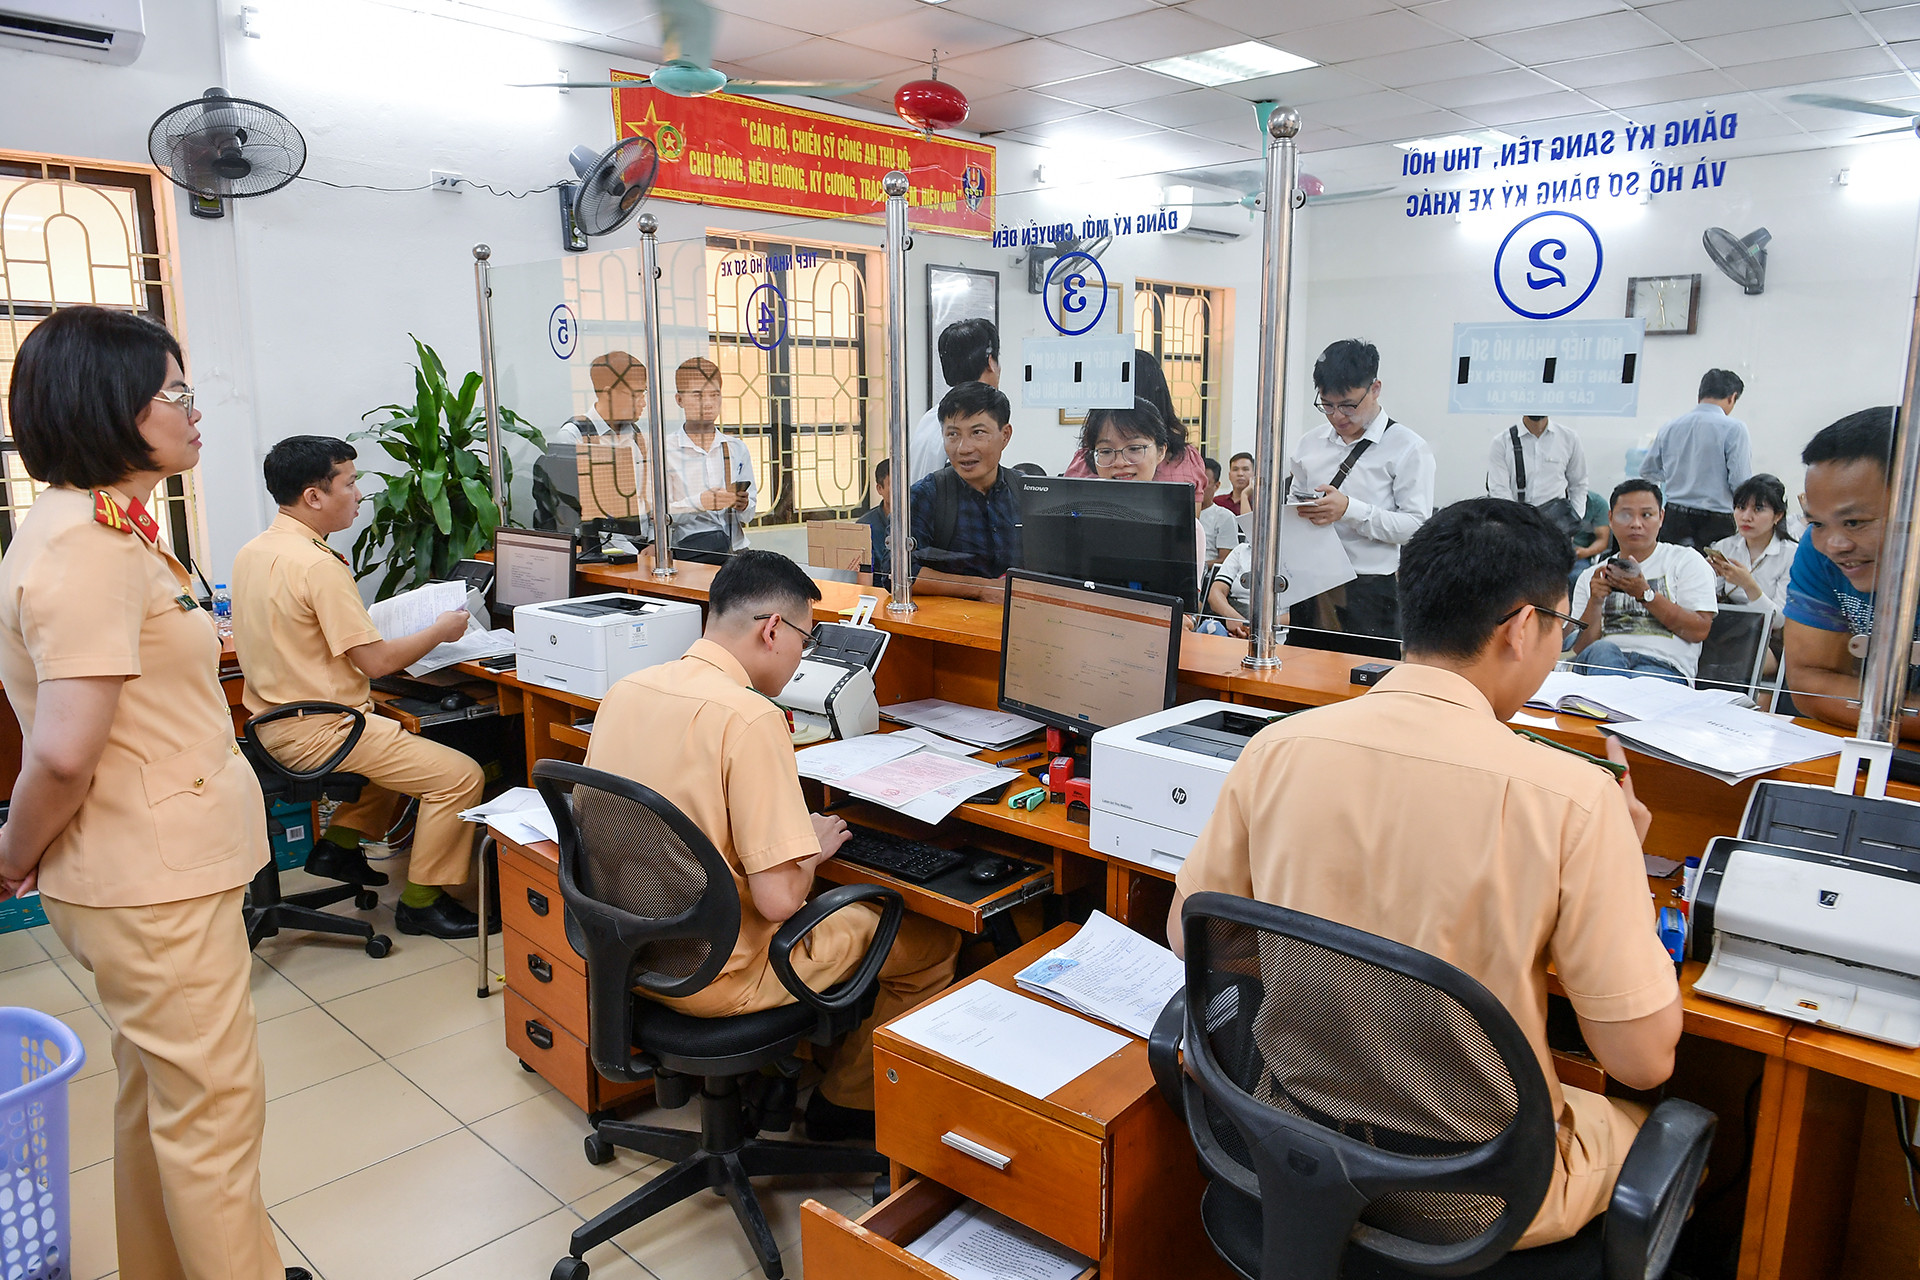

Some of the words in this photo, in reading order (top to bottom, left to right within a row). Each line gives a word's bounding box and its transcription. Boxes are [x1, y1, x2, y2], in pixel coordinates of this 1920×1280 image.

[773, 122, 790, 155] BỘ,
[792, 125, 821, 156] CHIẾN
[823, 132, 835, 159] SỸ
[837, 134, 863, 163] CÔNG
[864, 143, 877, 166] AN
[878, 138, 895, 169] THỦ
[689, 142, 711, 177] CHỦ
[713, 150, 746, 185] ĐỘNG,
[748, 156, 769, 185] NÊU
[772, 163, 808, 194] GƯƠNG,
[809, 161, 822, 193] KỶ
[824, 171, 858, 202] CƯƠNG,
[921, 185, 940, 214] HIỆU
[1023, 484, 1049, 492] lenovo
[1068, 725, 1079, 734] DELL
[1172, 786, 1187, 805] hp
